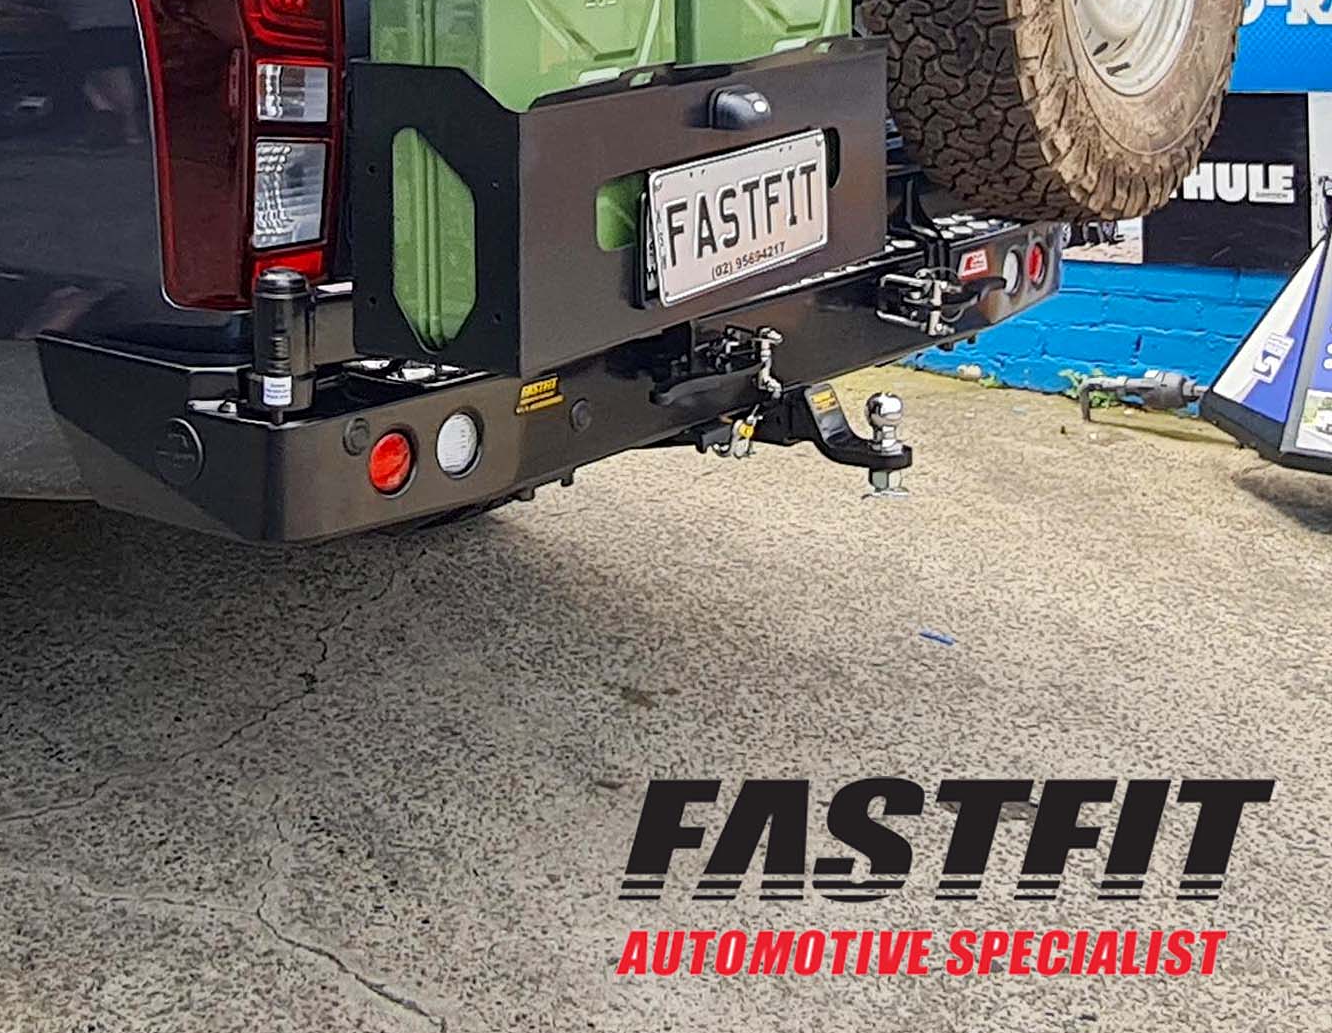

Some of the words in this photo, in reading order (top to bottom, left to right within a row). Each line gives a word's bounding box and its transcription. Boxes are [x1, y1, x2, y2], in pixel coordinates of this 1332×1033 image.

[1169, 162, 1294, 204] HULE
[665, 162, 818, 268] FASTFIT
[711, 262, 733, 281] (02)
